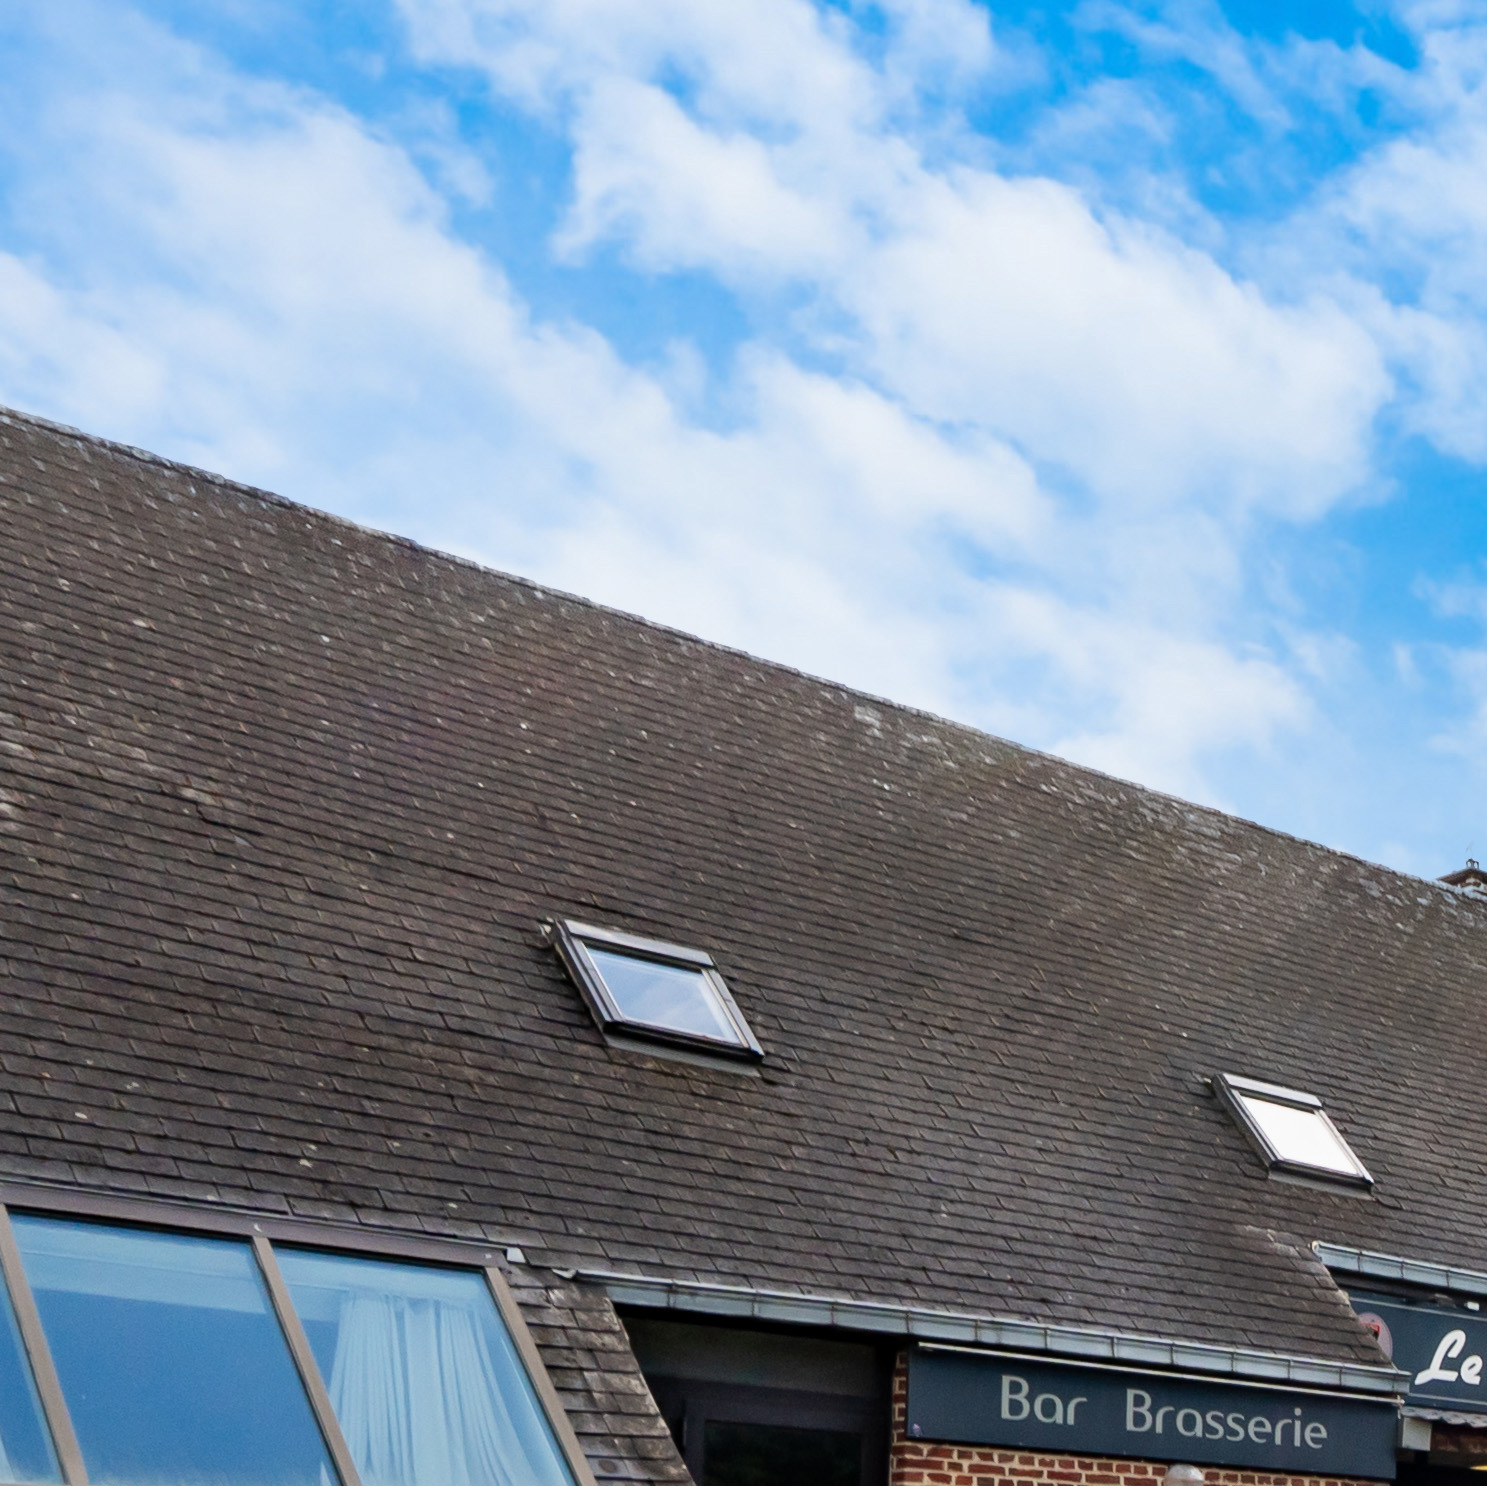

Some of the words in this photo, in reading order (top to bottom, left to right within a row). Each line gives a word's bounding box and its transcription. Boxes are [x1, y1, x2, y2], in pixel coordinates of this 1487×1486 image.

[1414, 1329, 1483, 1385] Le
[1000, 1374, 1087, 1426] Bar
[1126, 1388, 1328, 1449] Brasserie
